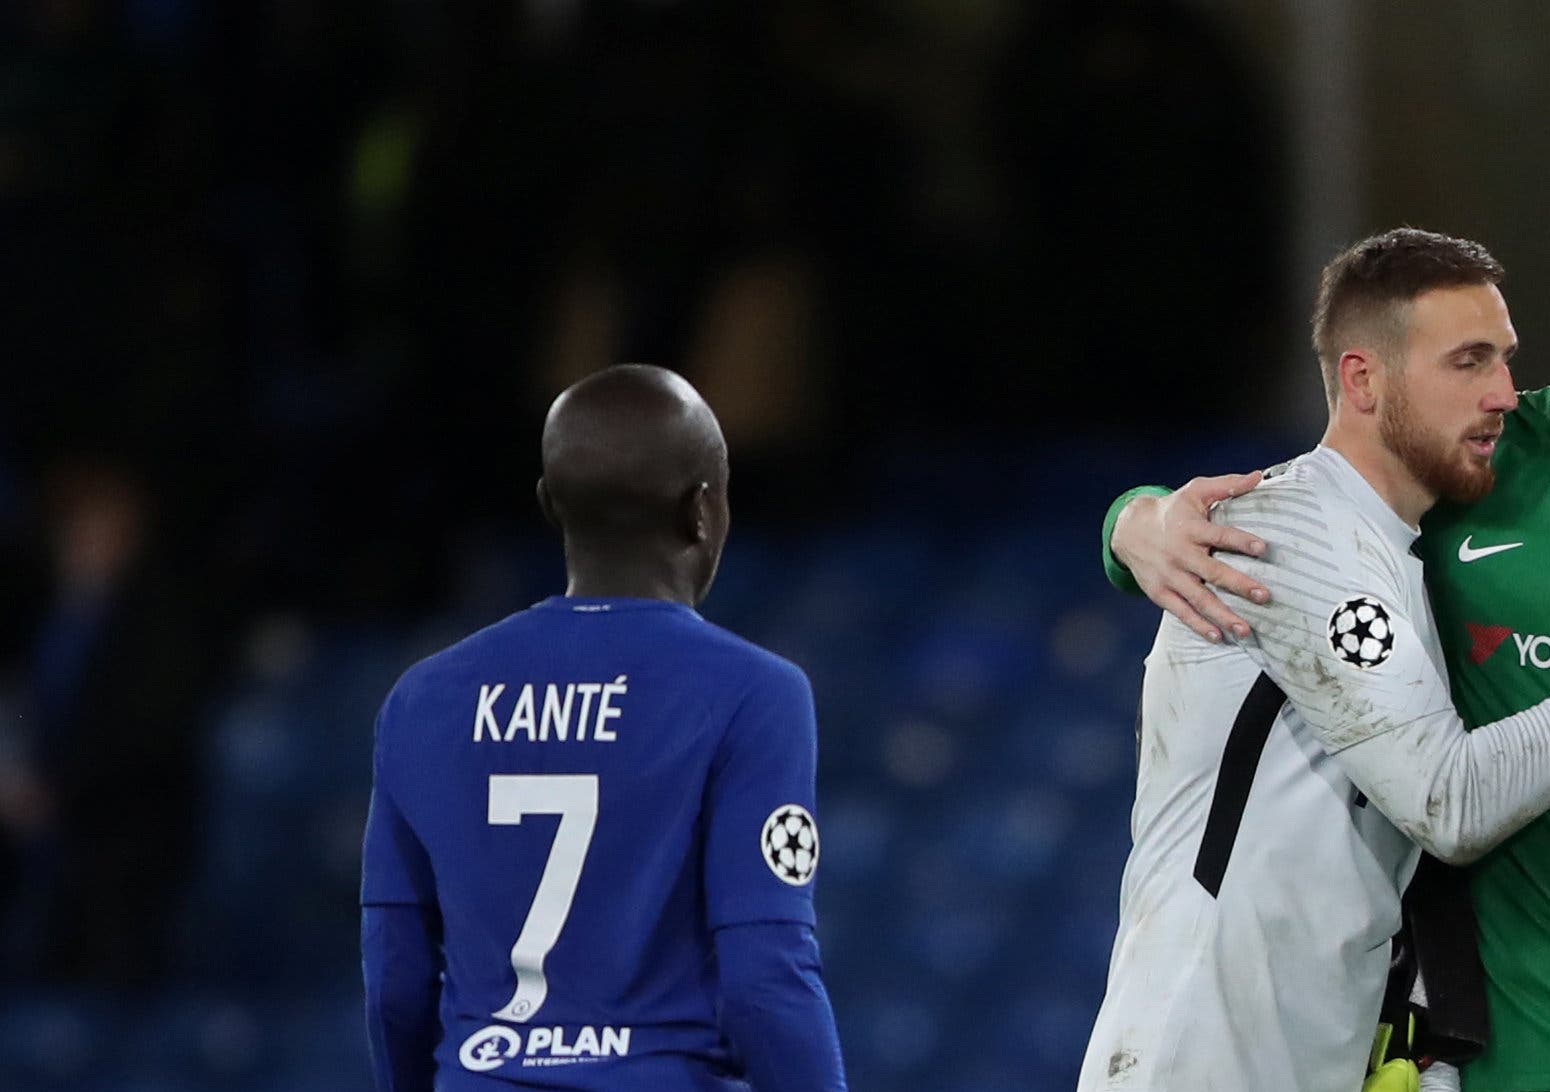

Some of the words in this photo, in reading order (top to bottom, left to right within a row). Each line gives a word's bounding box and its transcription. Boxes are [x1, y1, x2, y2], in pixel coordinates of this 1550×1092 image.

[473, 674, 628, 742] KANTÉ
[487, 774, 600, 1023] 7
[525, 1025, 632, 1057] PLAN
